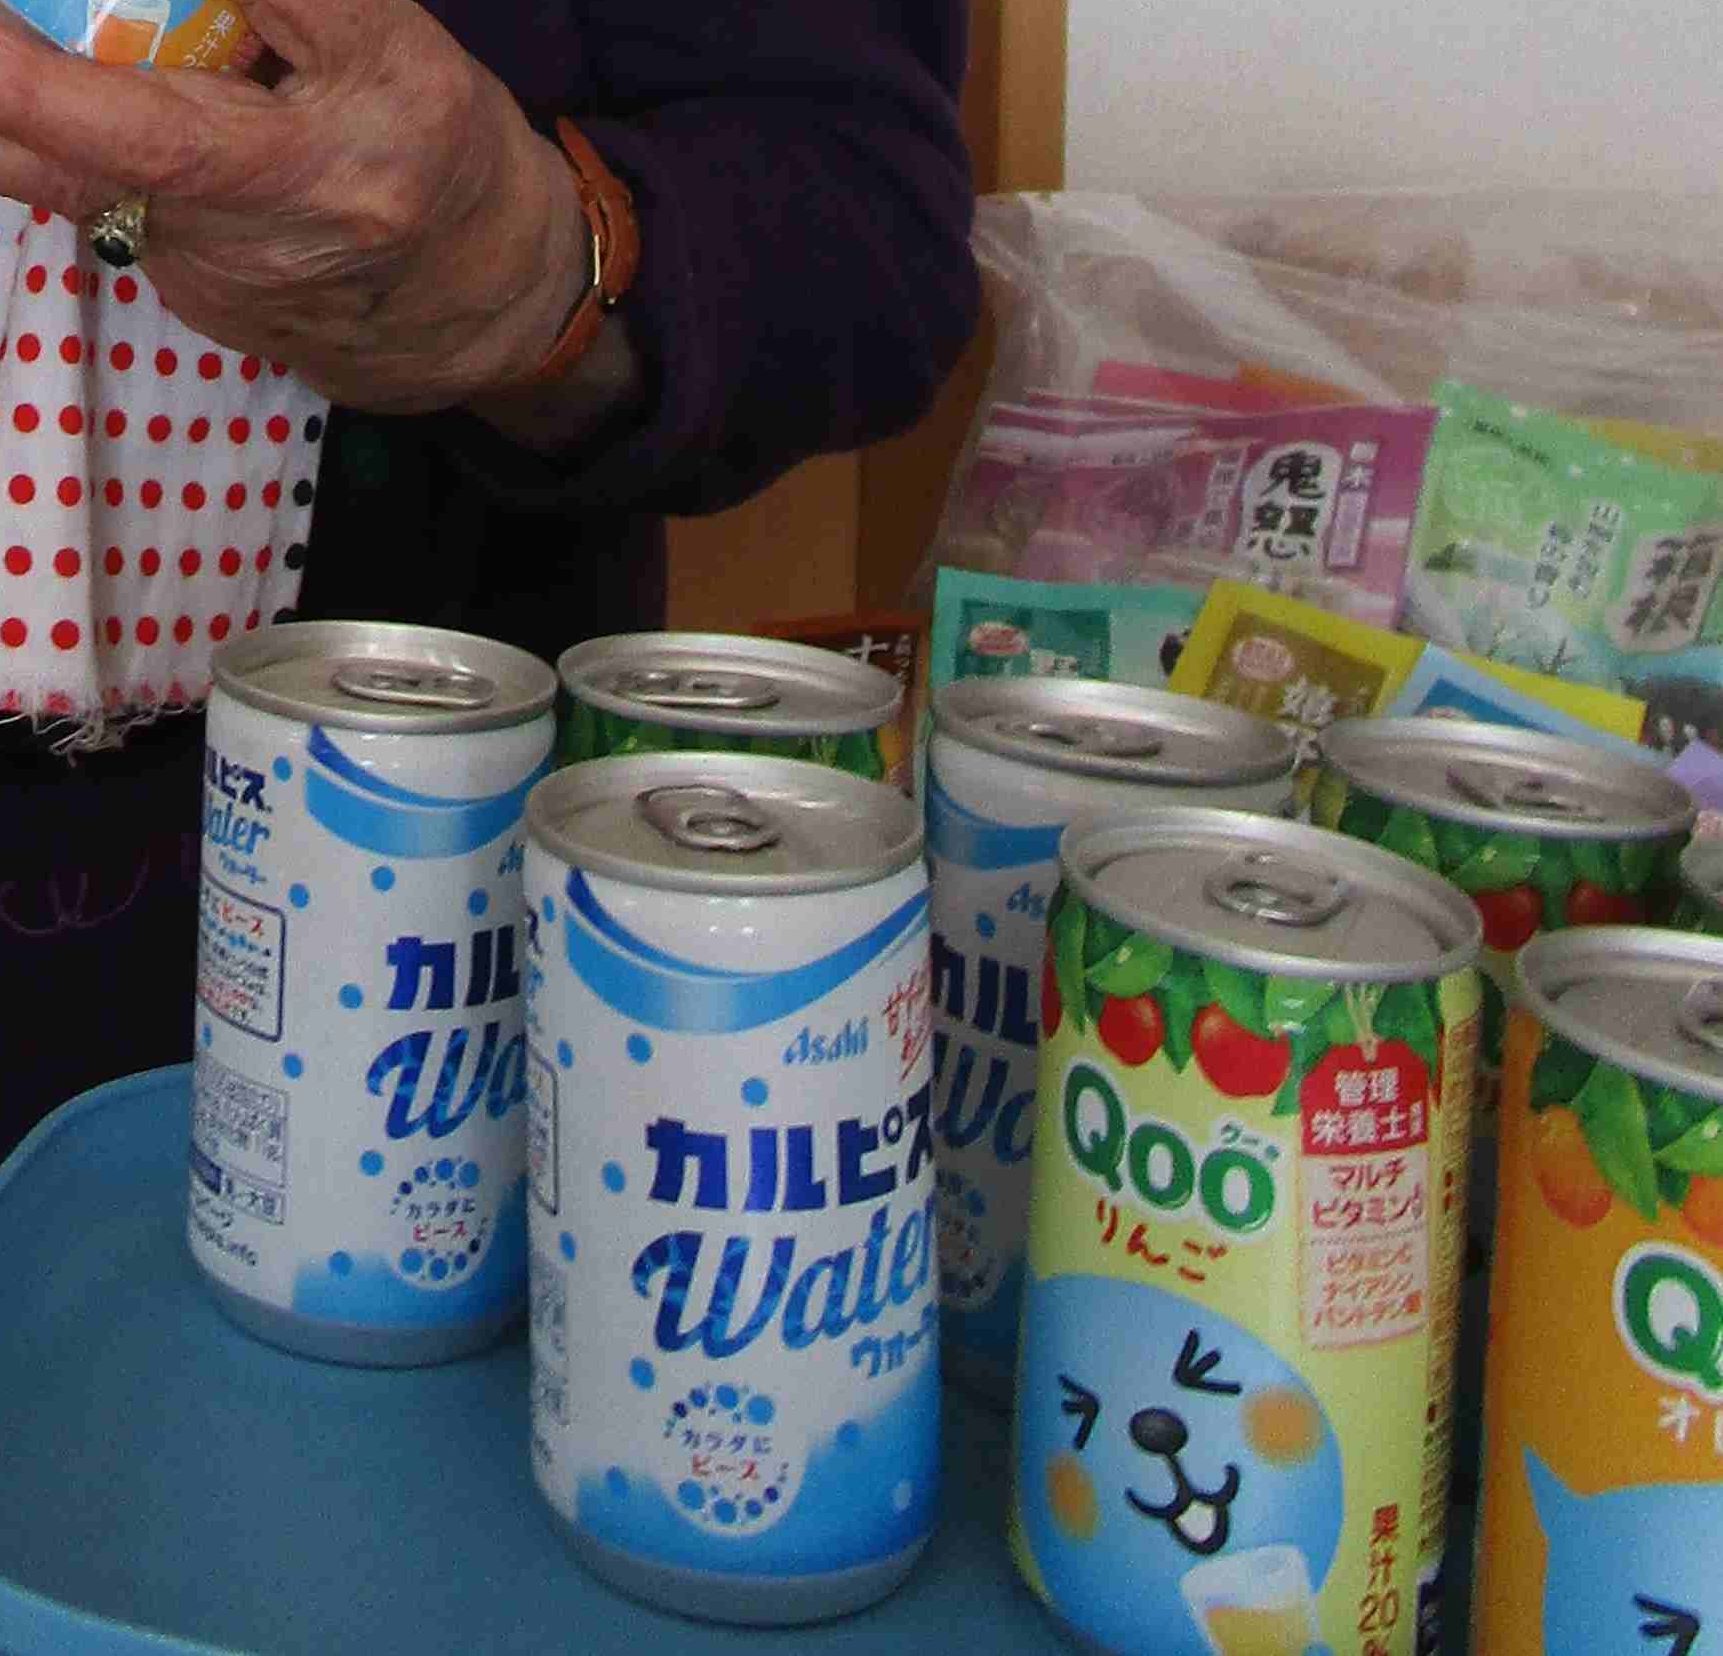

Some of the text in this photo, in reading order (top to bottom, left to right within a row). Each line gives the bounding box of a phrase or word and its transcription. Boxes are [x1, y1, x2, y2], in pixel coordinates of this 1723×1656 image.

[386, 924, 521, 1011] カル
[1335, 1066, 1399, 1107] 管理
[1329, 1155, 1408, 1189] マルチ
[631, 1196, 935, 1359] Wate
[1095, 1198, 1229, 1284] りんご
